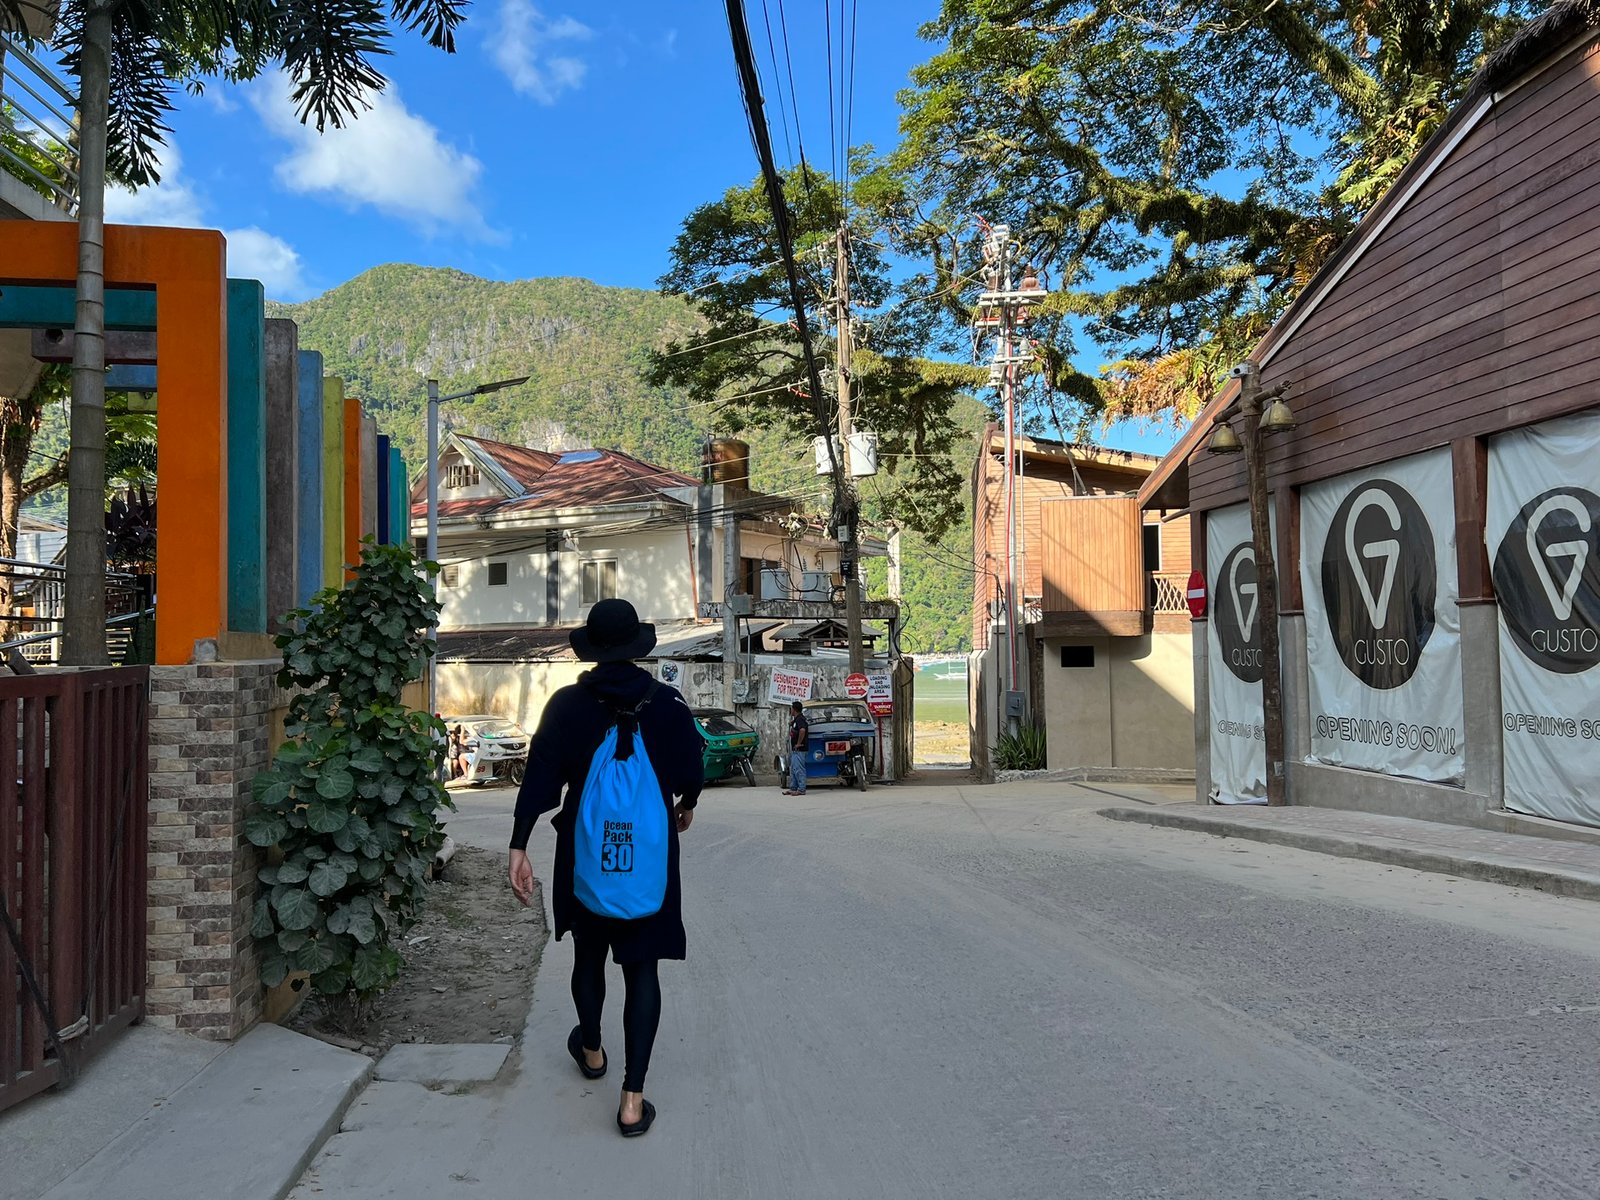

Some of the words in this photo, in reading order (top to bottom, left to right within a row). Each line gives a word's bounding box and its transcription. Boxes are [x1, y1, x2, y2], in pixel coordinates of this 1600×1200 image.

[1354, 638, 1410, 666] GUSTO
[1530, 628, 1598, 653] GUSTO
[773, 673, 799, 686] DESIGNATED
[799, 677, 810, 688] AREA
[777, 684, 786, 694] FOR
[787, 685, 807, 698] TRICYCLE
[1316, 715, 1394, 747] OPENING
[1396, 722, 1456, 755] SOON!
[1503, 712, 1578, 738] OPENING
[603, 830, 633, 842] Pack
[604, 820, 633, 830] Ocean
[602, 844, 632, 871] 30
